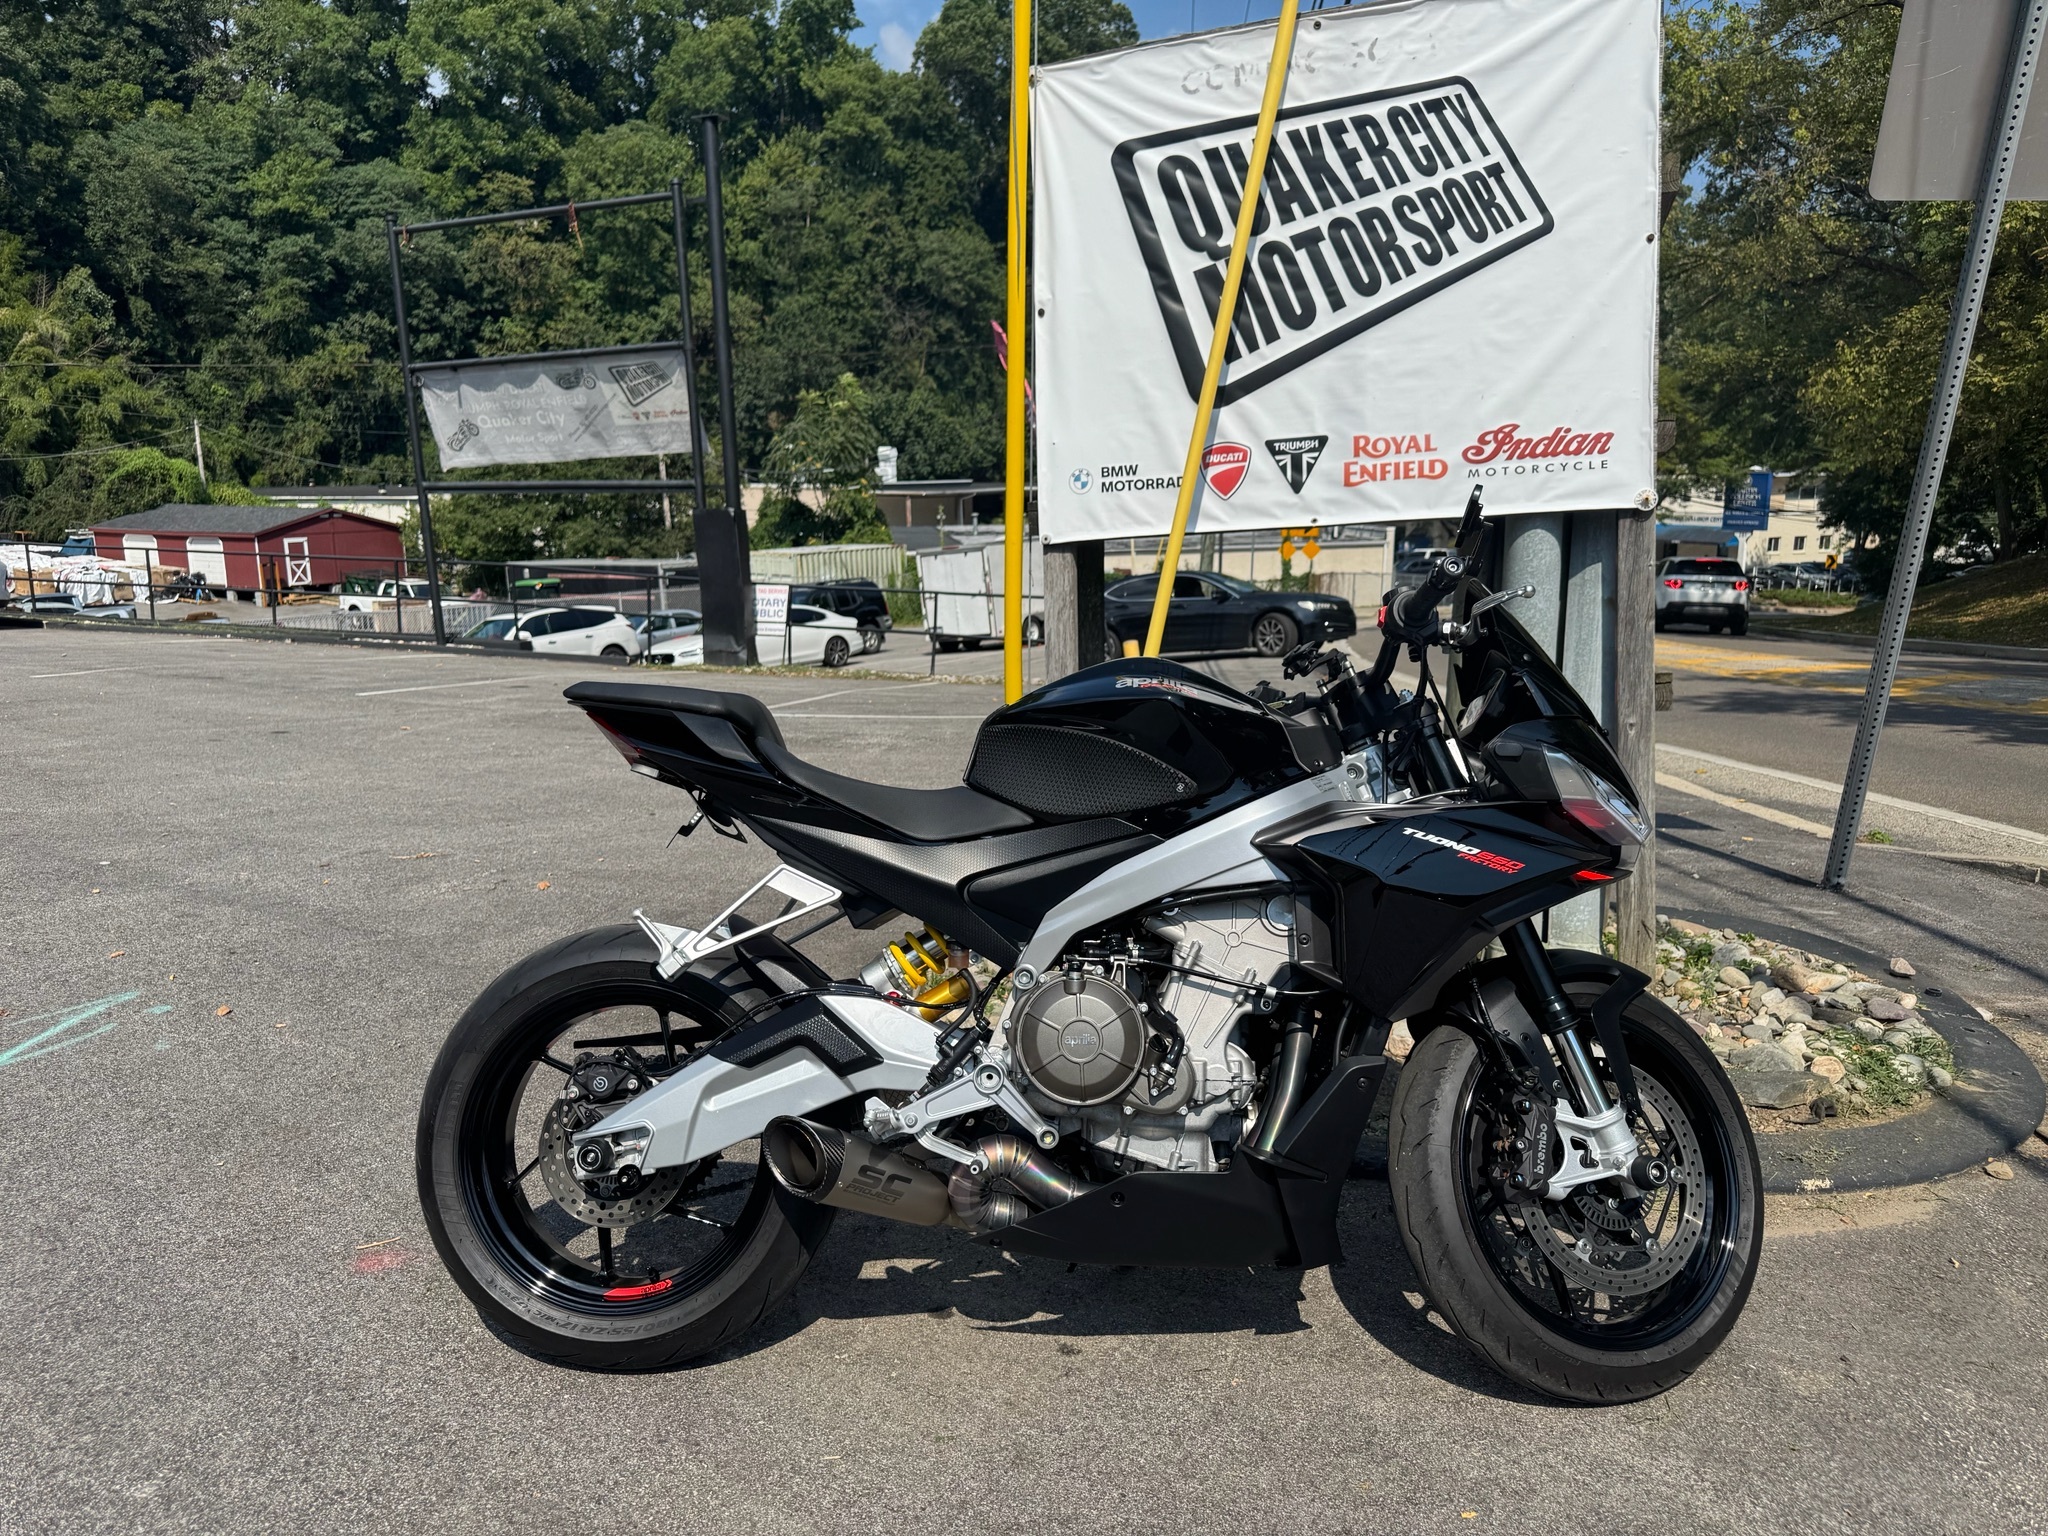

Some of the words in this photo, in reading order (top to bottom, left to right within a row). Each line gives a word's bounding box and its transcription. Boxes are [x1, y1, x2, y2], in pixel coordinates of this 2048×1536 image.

[1157, 113, 1411, 262] QUAKER
[1386, 93, 1492, 178] CITY
[1193, 161, 1528, 366] MOTORSPORT
[477, 412, 532, 429] Quaker
[536, 409, 565, 427] City
[1273, 439, 1319, 452] TRIUMPH
[1352, 433, 1438, 459] ROYAL
[1461, 423, 1615, 465] Indian
[1205, 451, 1243, 464] DUCATI
[1467, 459, 1609, 479] MOTORCYCLE
[1101, 464, 1139, 478] BMW
[1343, 458, 1448, 487] ENFIELD
[752, 598, 786, 607] OTARY
[1402, 826, 1482, 855] TUONO
[1477, 850, 1526, 870] 660
[1457, 852, 1518, 875] FACTORY
[1064, 1033, 1097, 1047] aprilia
[1533, 1123, 1549, 1175] brembo
[851, 1164, 913, 1197] SC
[845, 1182, 902, 1203] PROJECT
